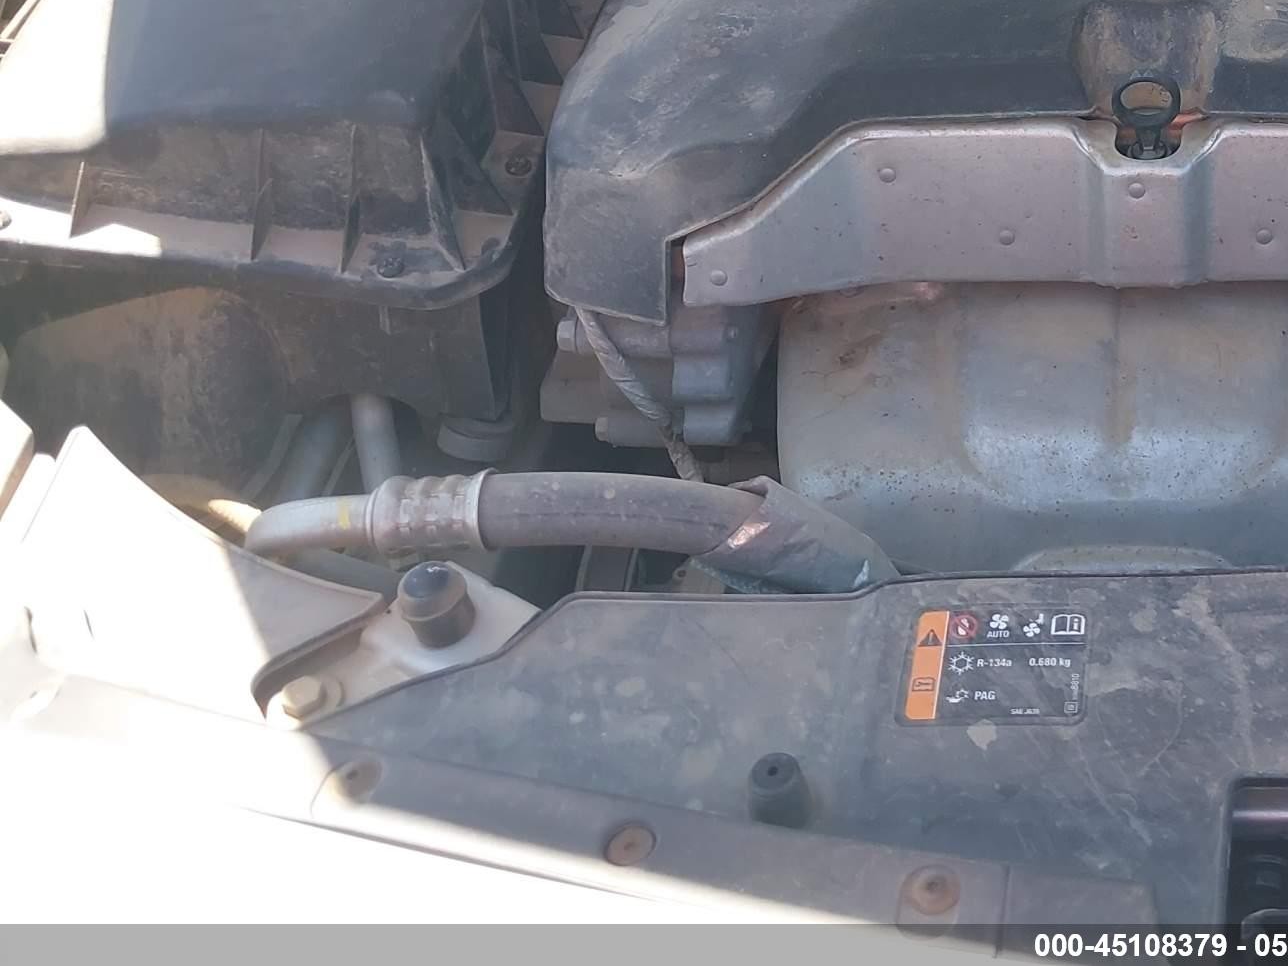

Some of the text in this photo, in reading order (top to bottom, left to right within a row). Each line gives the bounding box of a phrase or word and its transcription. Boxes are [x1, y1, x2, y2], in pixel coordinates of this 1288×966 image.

[987, 630, 1009, 638] AUTO
[976, 657, 1072, 669] R-134a 0.680 kg
[974, 690, 996, 701] PAG
